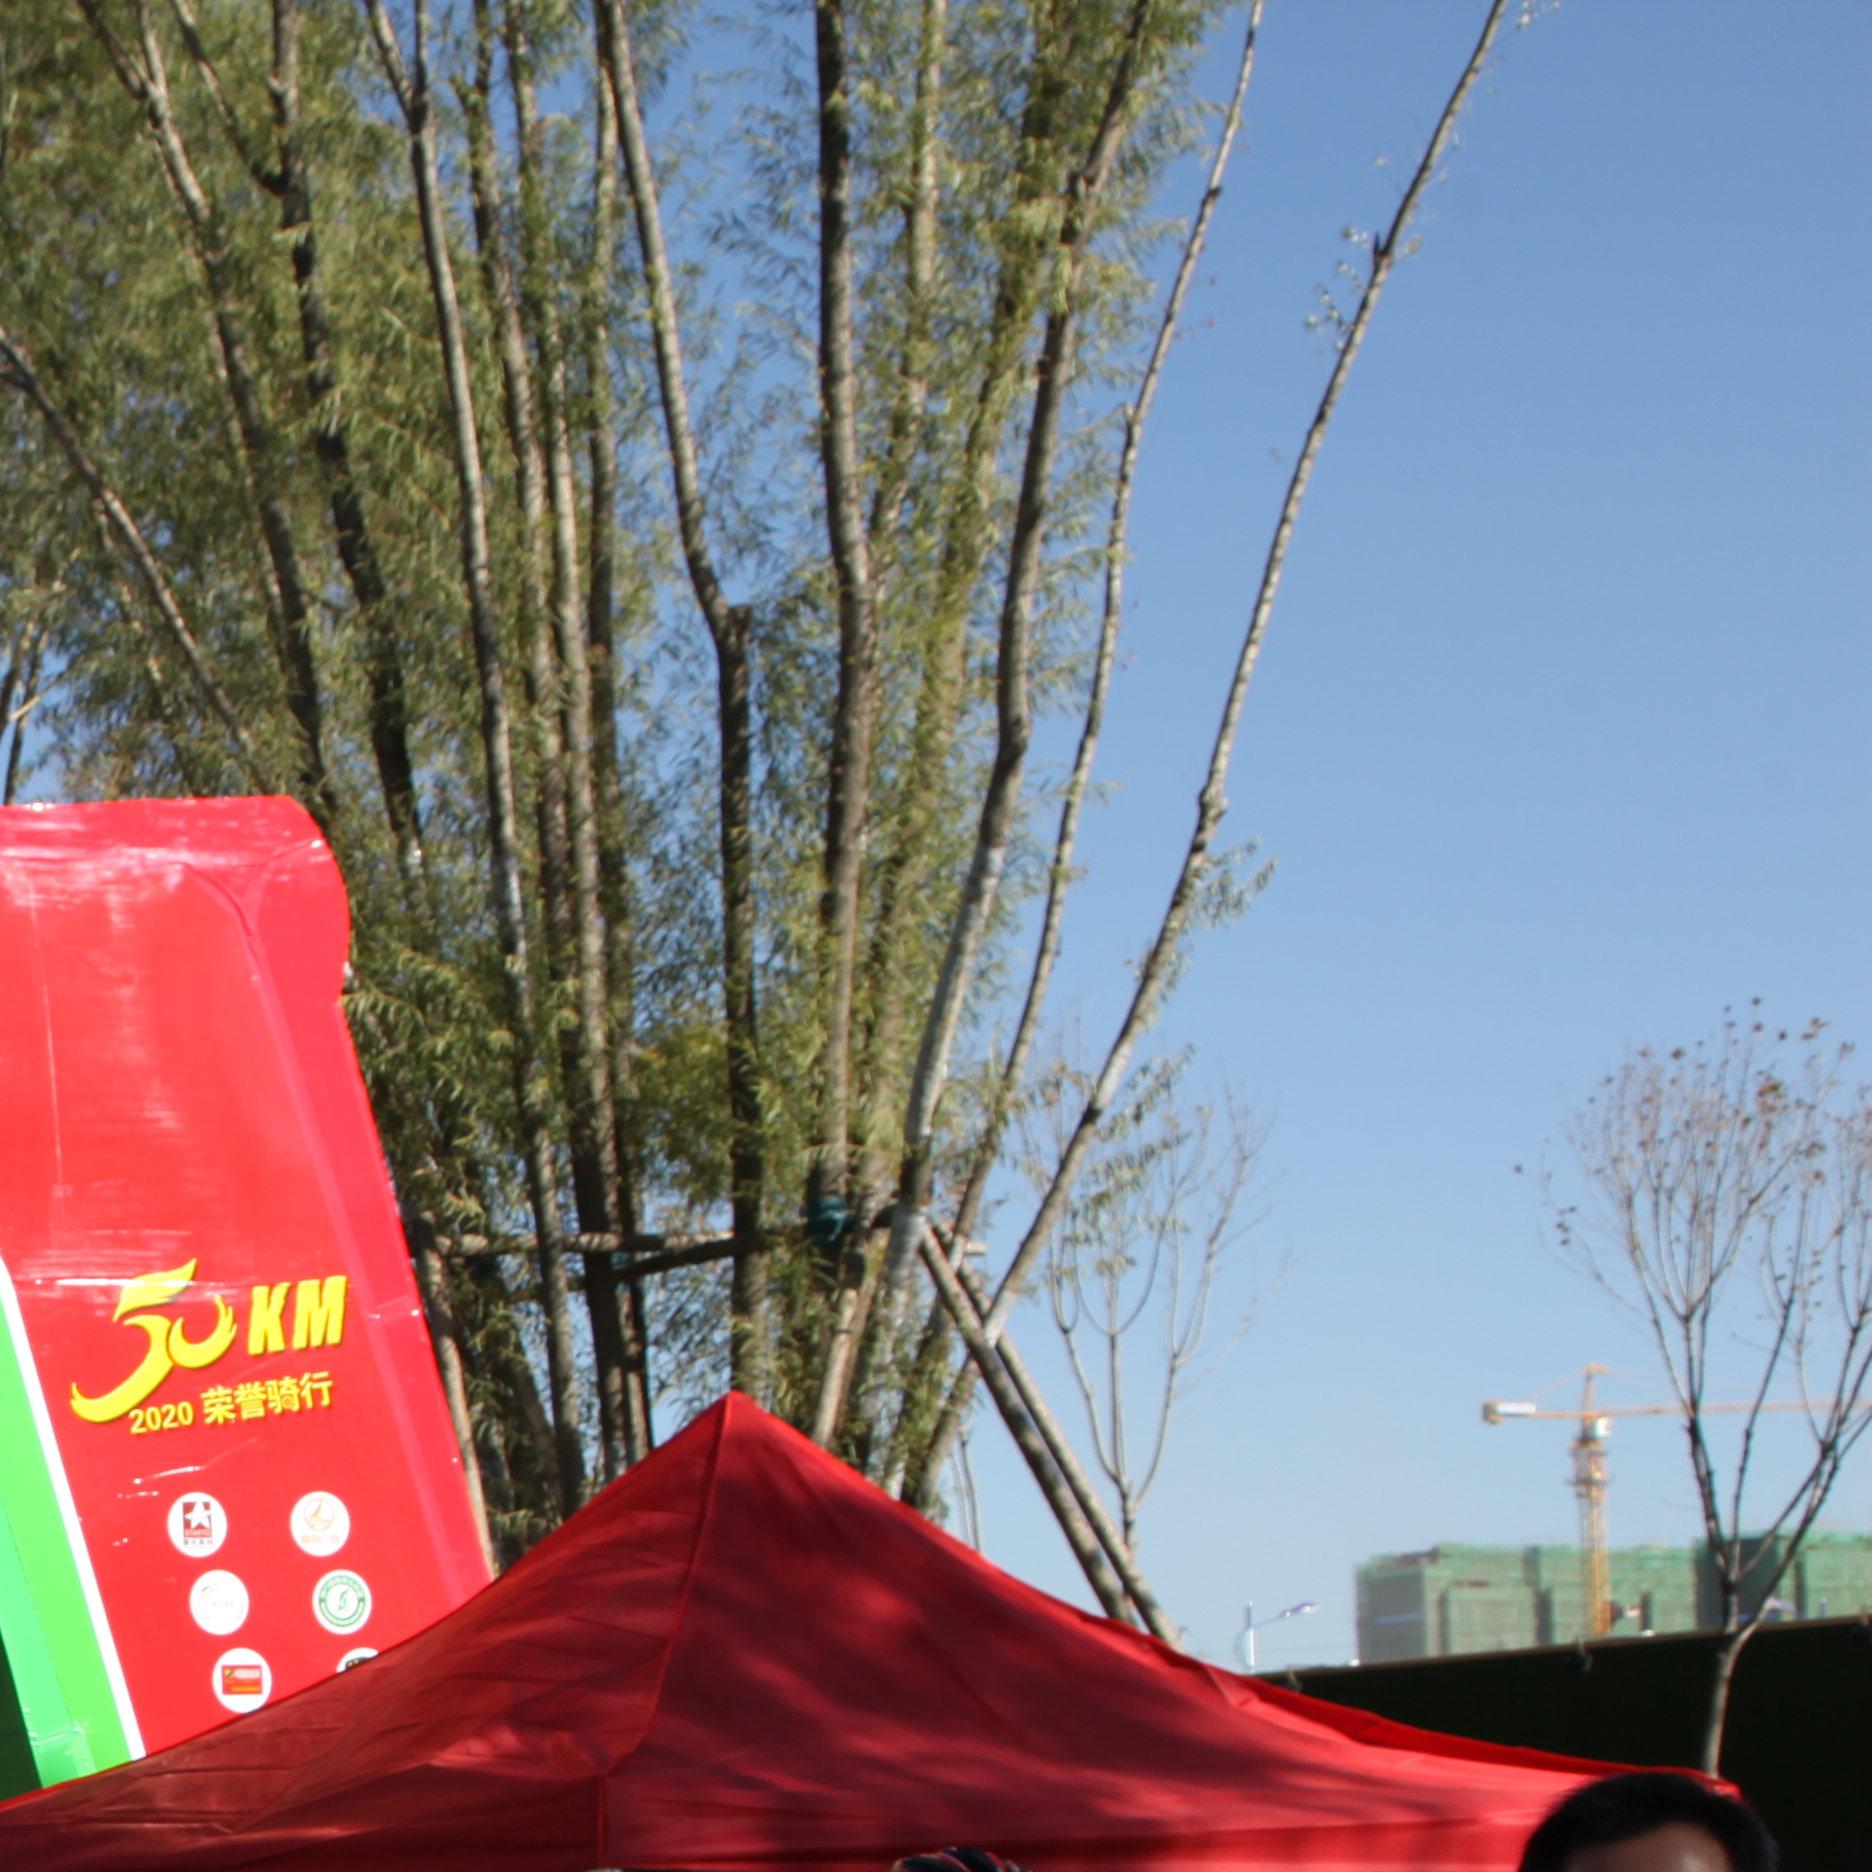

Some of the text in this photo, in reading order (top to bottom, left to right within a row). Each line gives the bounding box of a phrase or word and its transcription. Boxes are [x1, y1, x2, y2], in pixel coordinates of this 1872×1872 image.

[128, 1371, 334, 1434] 2020 荣誉骑行
